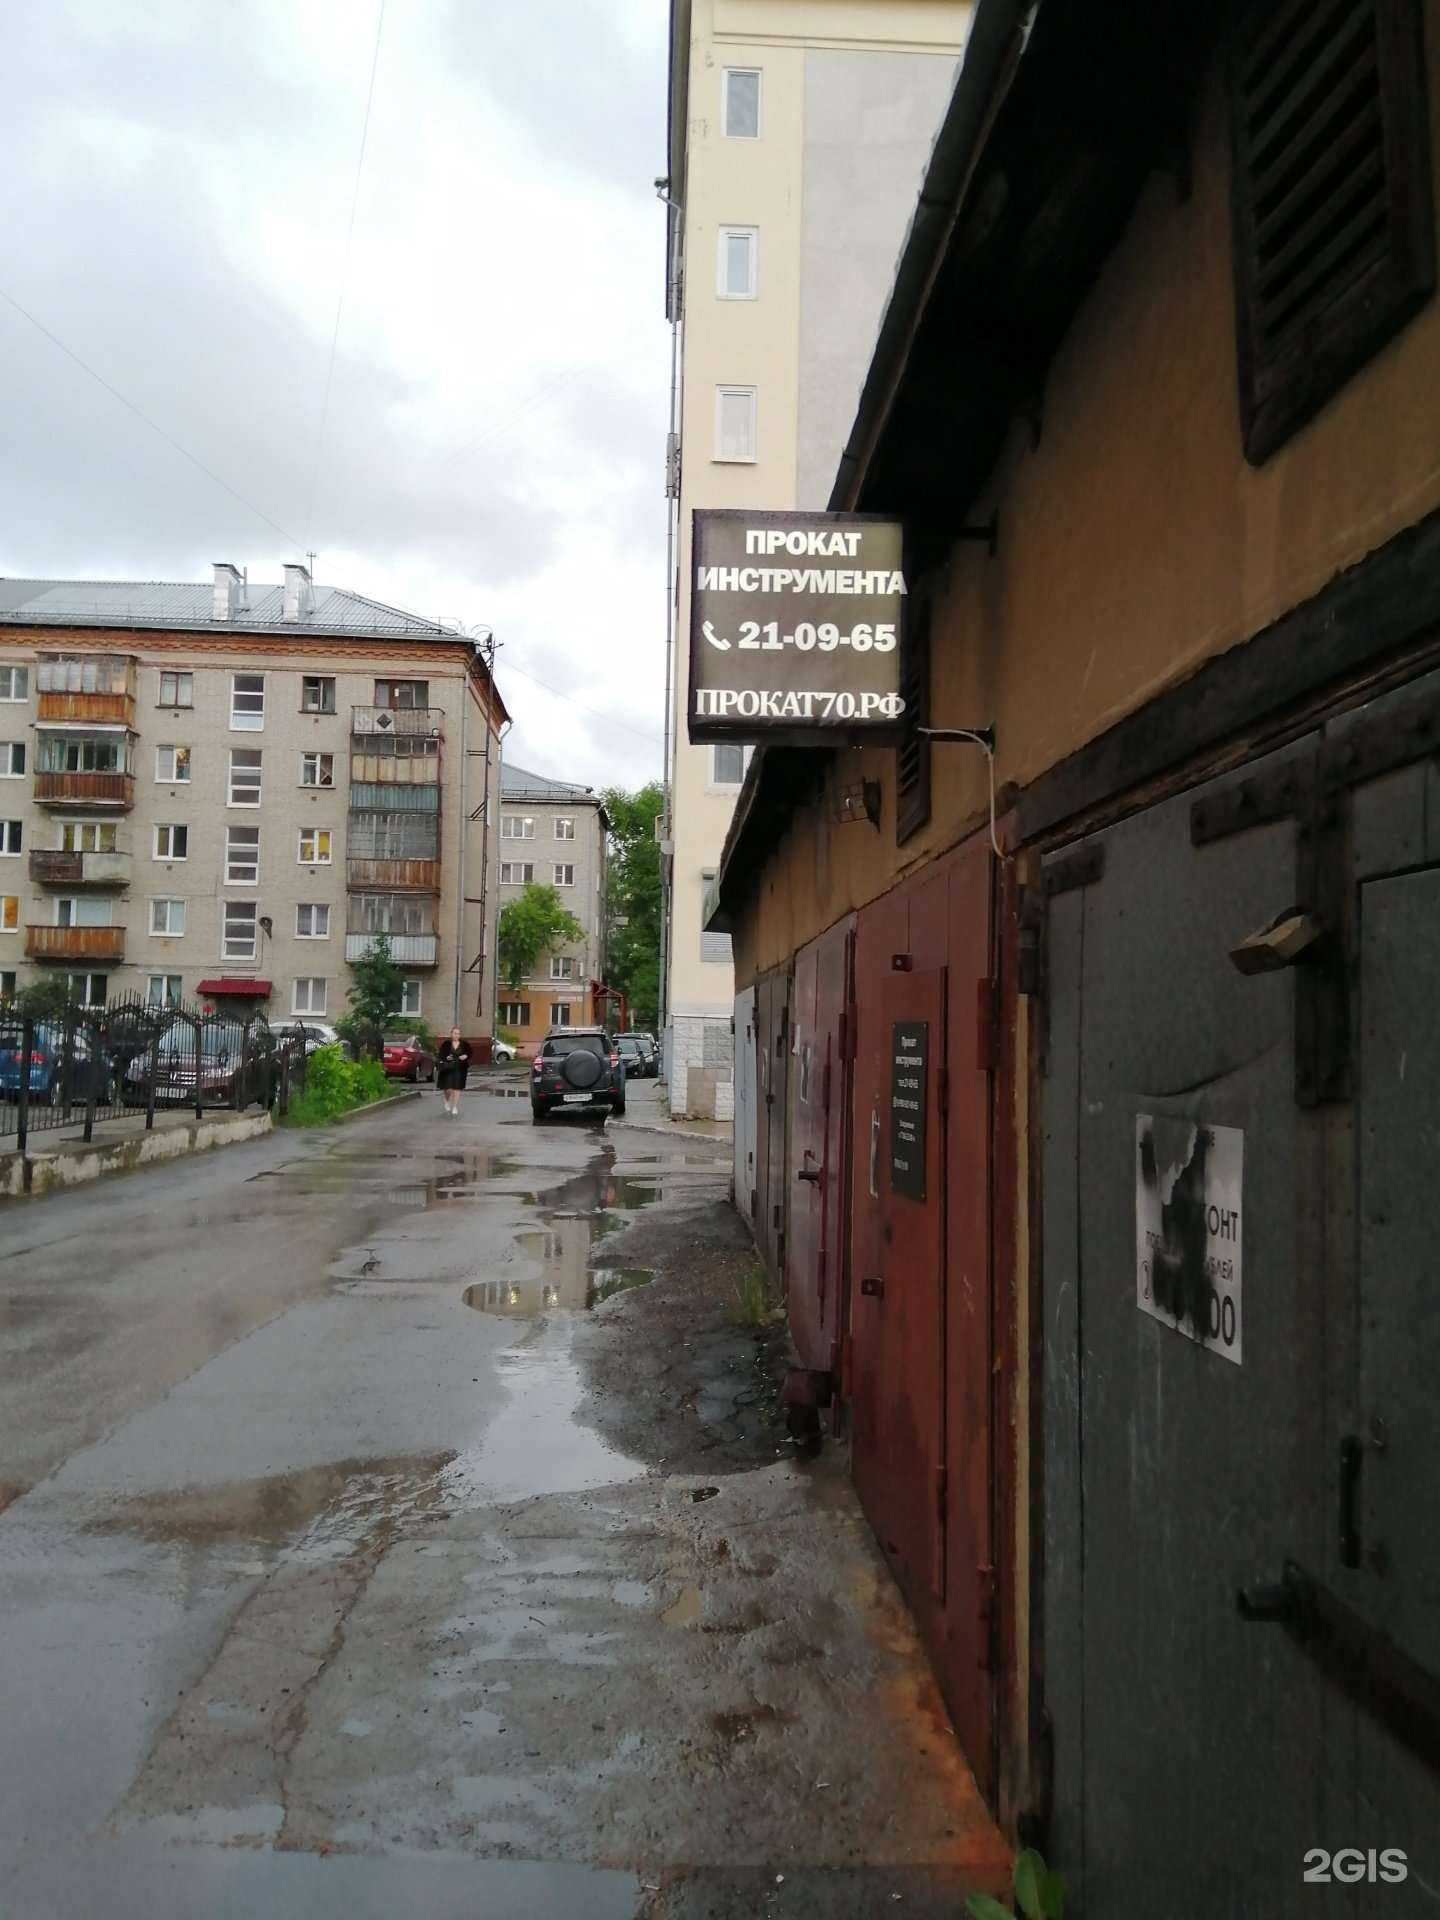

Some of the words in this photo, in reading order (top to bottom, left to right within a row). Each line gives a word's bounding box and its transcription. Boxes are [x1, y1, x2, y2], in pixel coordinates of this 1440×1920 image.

[745, 529, 862, 557] ПРОКАТ
[697, 566, 909, 595] ИНСТРУМЕНТА
[738, 620, 897, 652] 21-09-65
[695, 688, 906, 719] ПРОКАТ70.РФ
[1207, 1205, 1238, 1242] ОНТ
